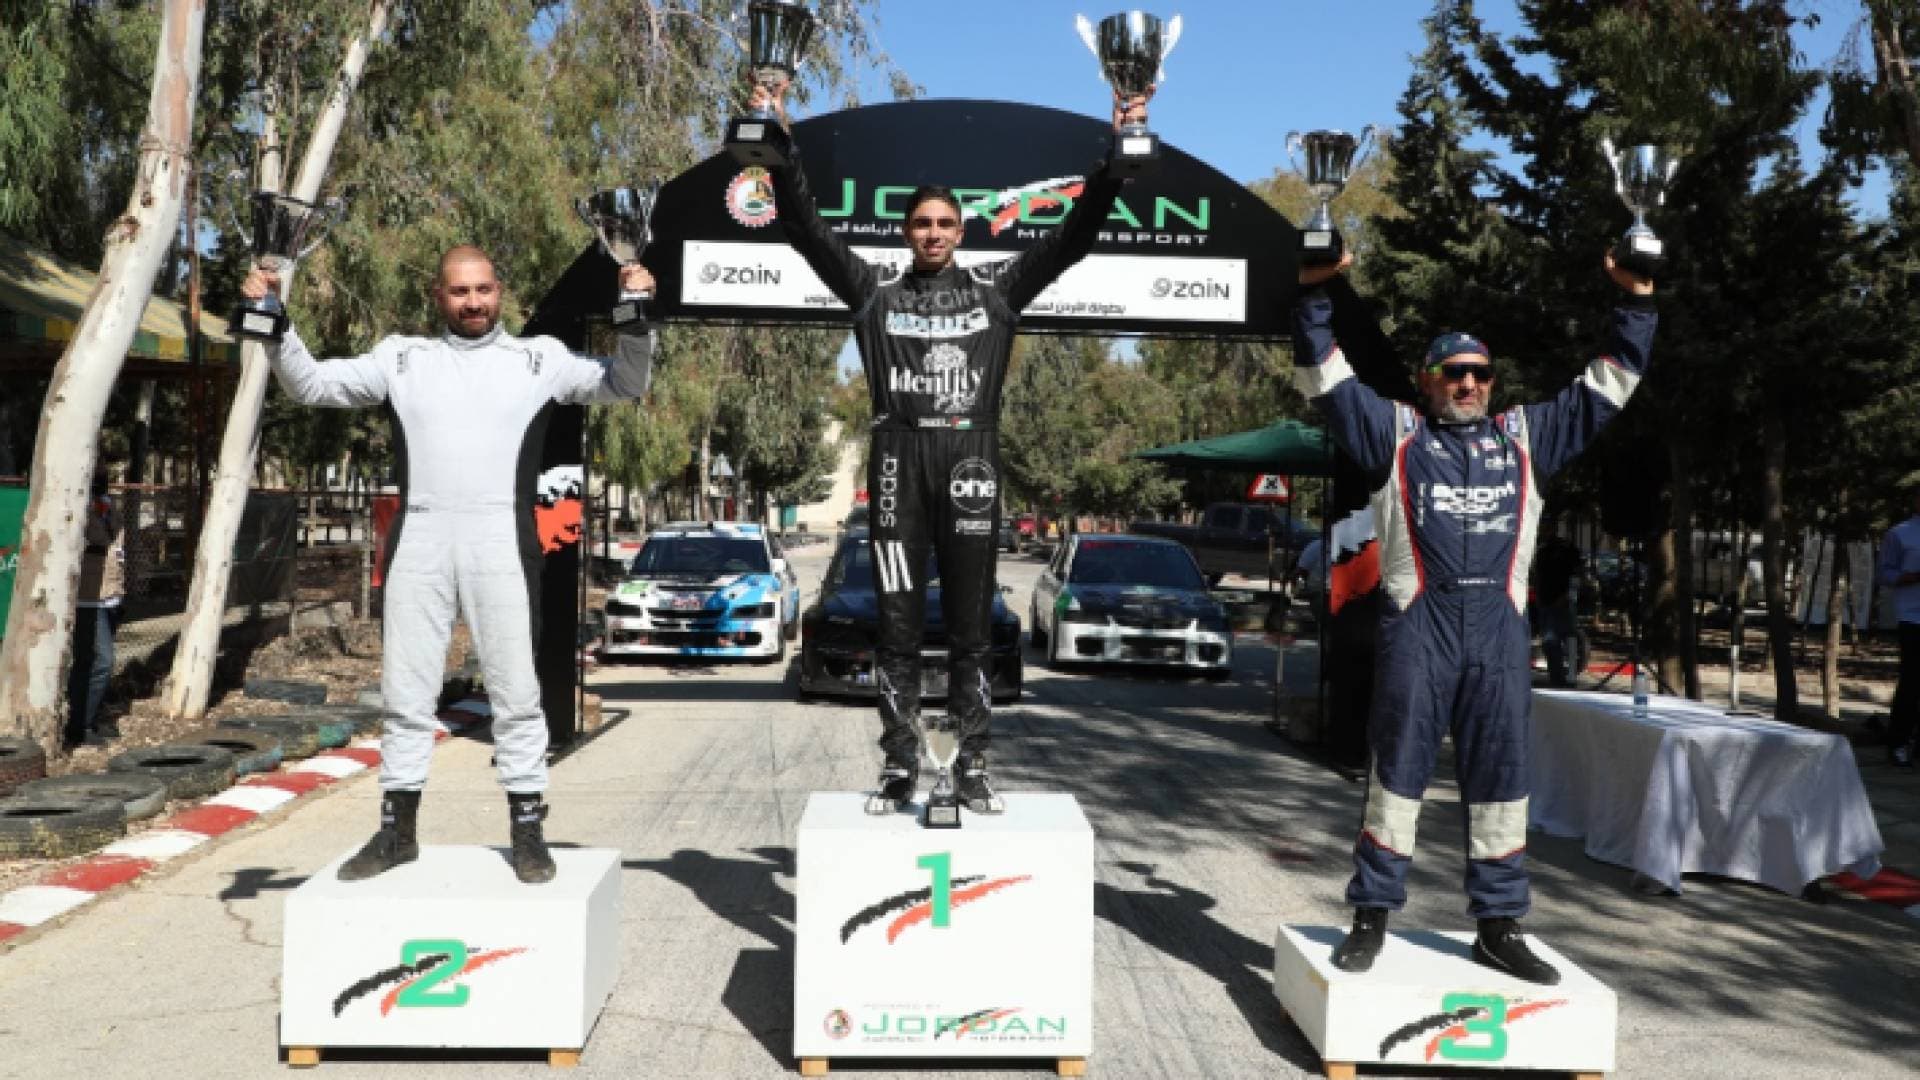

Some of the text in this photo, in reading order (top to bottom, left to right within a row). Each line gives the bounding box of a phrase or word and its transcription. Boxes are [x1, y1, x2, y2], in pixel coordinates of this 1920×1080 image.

[818, 177, 1210, 230] JORDAN
[1018, 228, 1208, 245] MRSPORT
[950, 478, 997, 498] one
[917, 851, 951, 928] 1
[397, 939, 470, 1007] 2
[862, 1012, 1066, 1036] JORDAN
[1438, 993, 1508, 1061] 3
